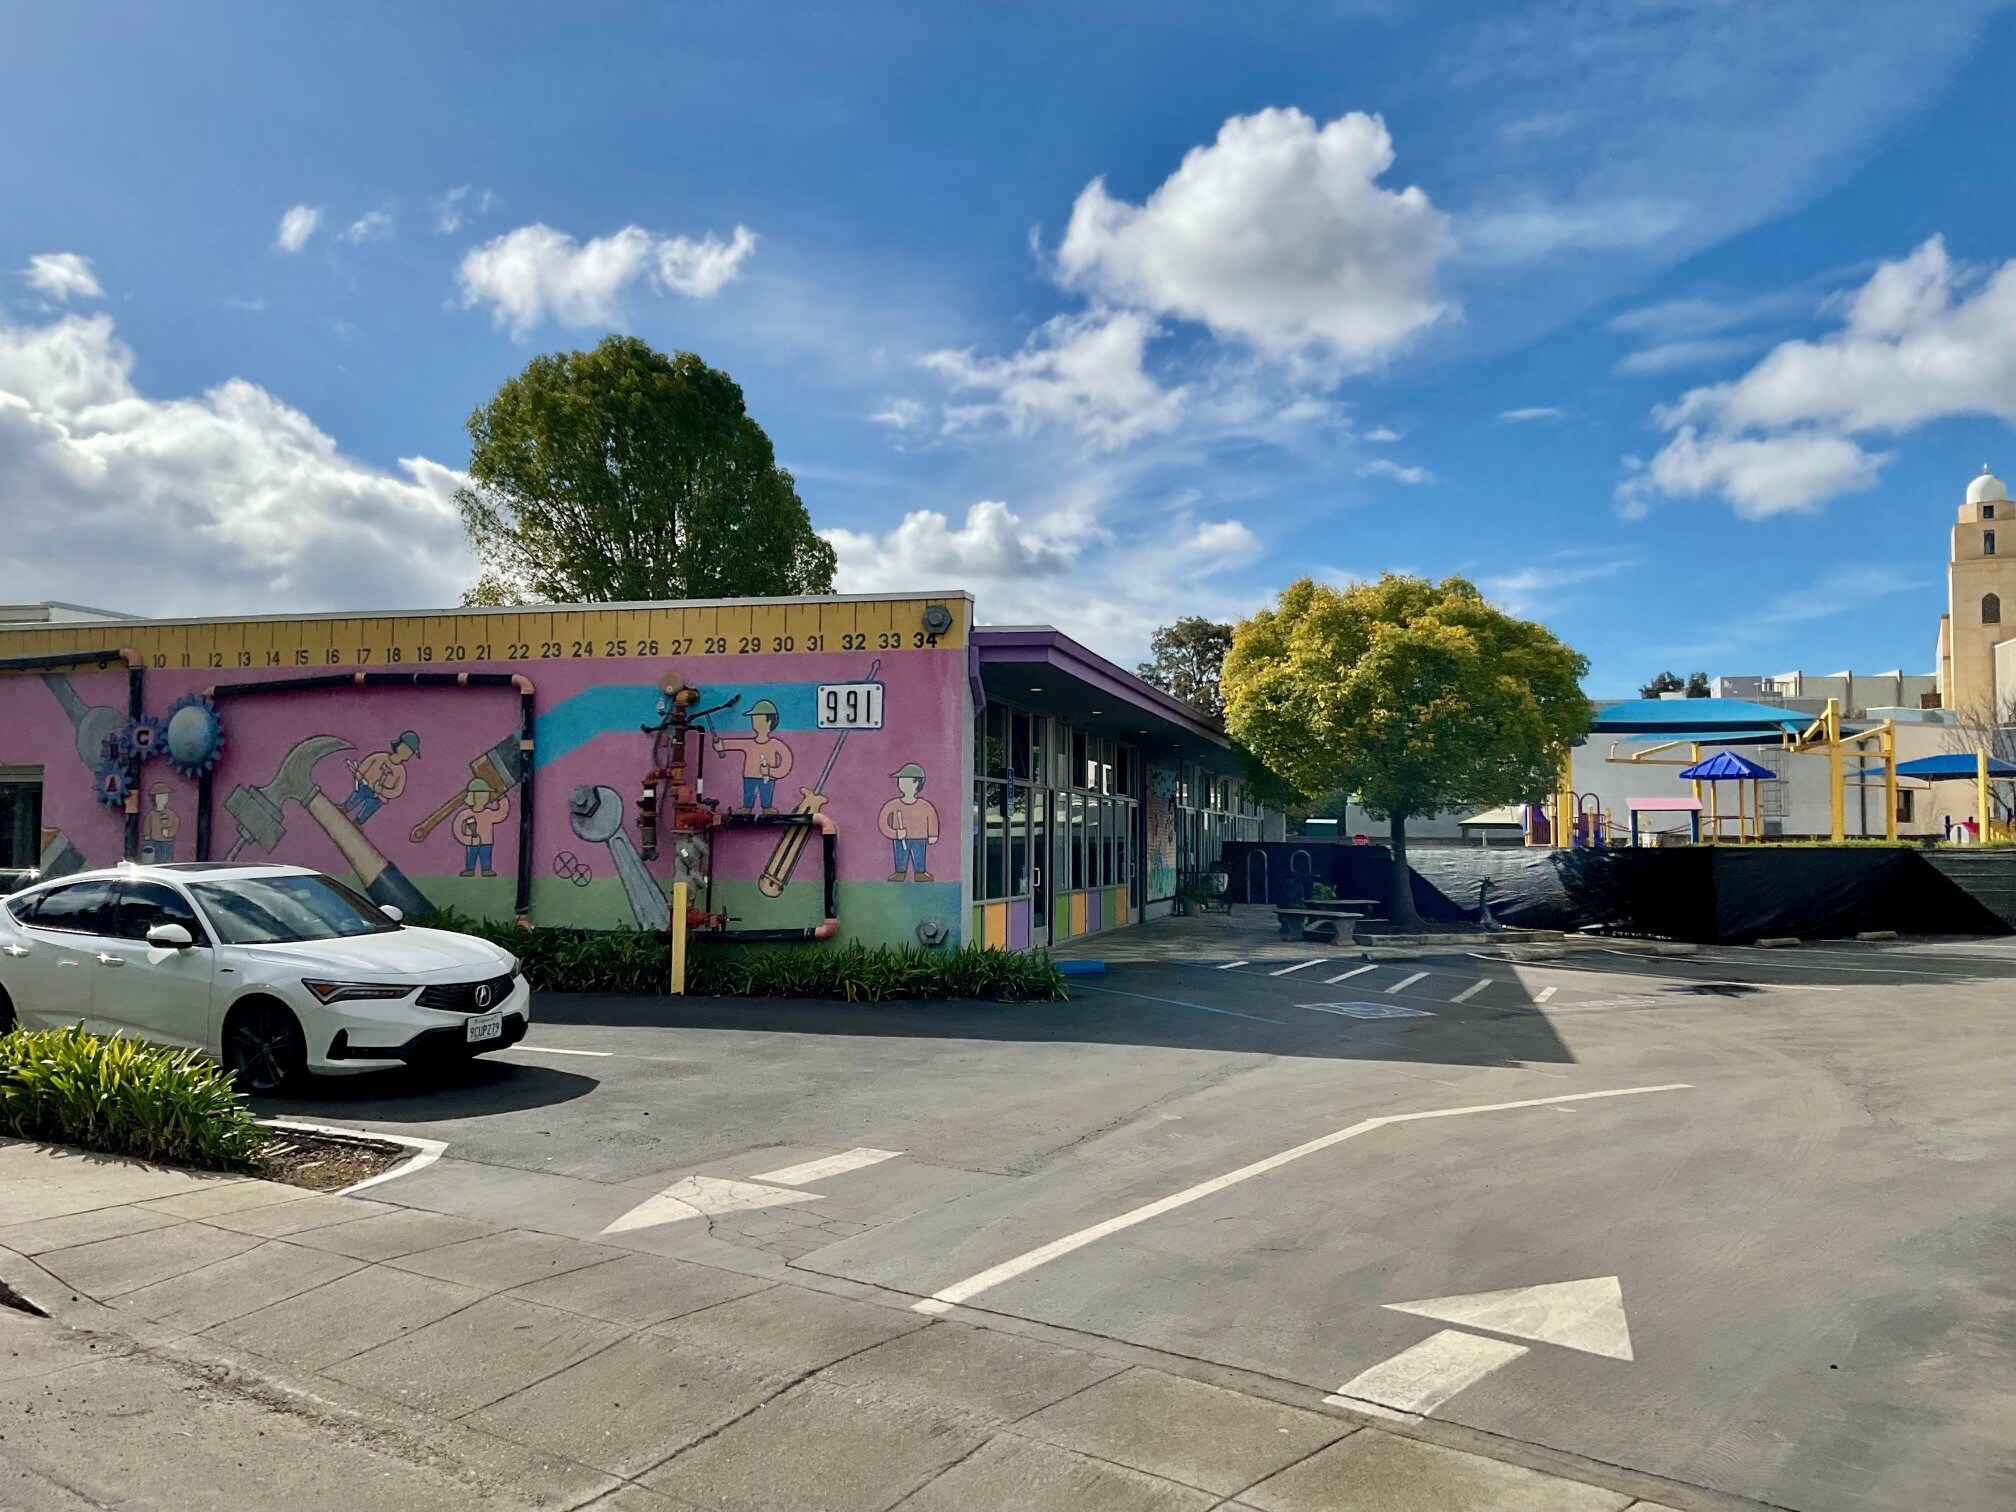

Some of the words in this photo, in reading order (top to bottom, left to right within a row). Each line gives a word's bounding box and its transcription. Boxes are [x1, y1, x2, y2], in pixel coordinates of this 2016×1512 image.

[152, 653, 167, 669] 10
[181, 652, 191, 668] 11
[208, 652, 223, 668] 12
[237, 651, 251, 667] 13
[265, 650, 281, 667] 14
[295, 649, 309, 666] 15
[325, 648, 340, 665] 16
[356, 648, 372, 664] 17
[386, 647, 402, 664] 18
[417, 645, 433, 662] 19
[445, 645, 466, 662] 20
[475, 644, 491, 661] 21
[508, 643, 530, 660] 22
[541, 642, 562, 659] 23
[572, 640, 594, 659] 24
[605, 639, 627, 657] 25
[637, 639, 659, 657] 26
[671, 638, 694, 656] 27
[704, 637, 727, 654] 28
[738, 636, 761, 655] 29
[772, 635, 795, 653] 30
[806, 634, 824, 652] 31
[841, 633, 866, 651] 32
[878, 632, 901, 650] 33
[913, 631, 938, 649] 34
[826, 690, 871, 724] 991
